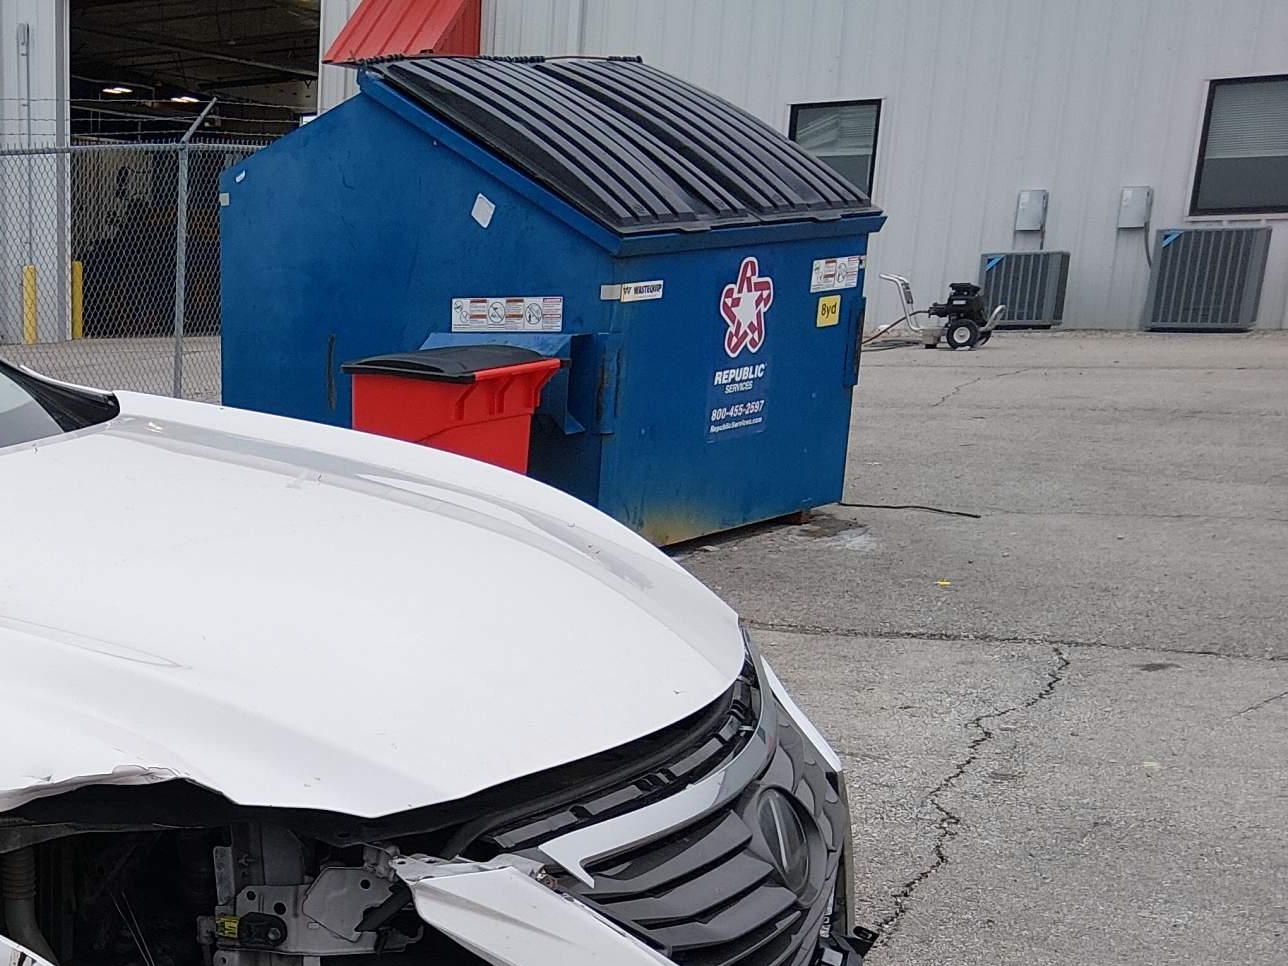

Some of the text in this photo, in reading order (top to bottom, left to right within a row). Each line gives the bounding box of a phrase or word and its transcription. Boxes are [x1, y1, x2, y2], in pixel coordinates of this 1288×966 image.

[820, 302, 837, 319] 8yd
[714, 364, 766, 385] REPUBLIC
[724, 380, 753, 394] SERVICES
[711, 400, 765, 421] 800-455-2597
